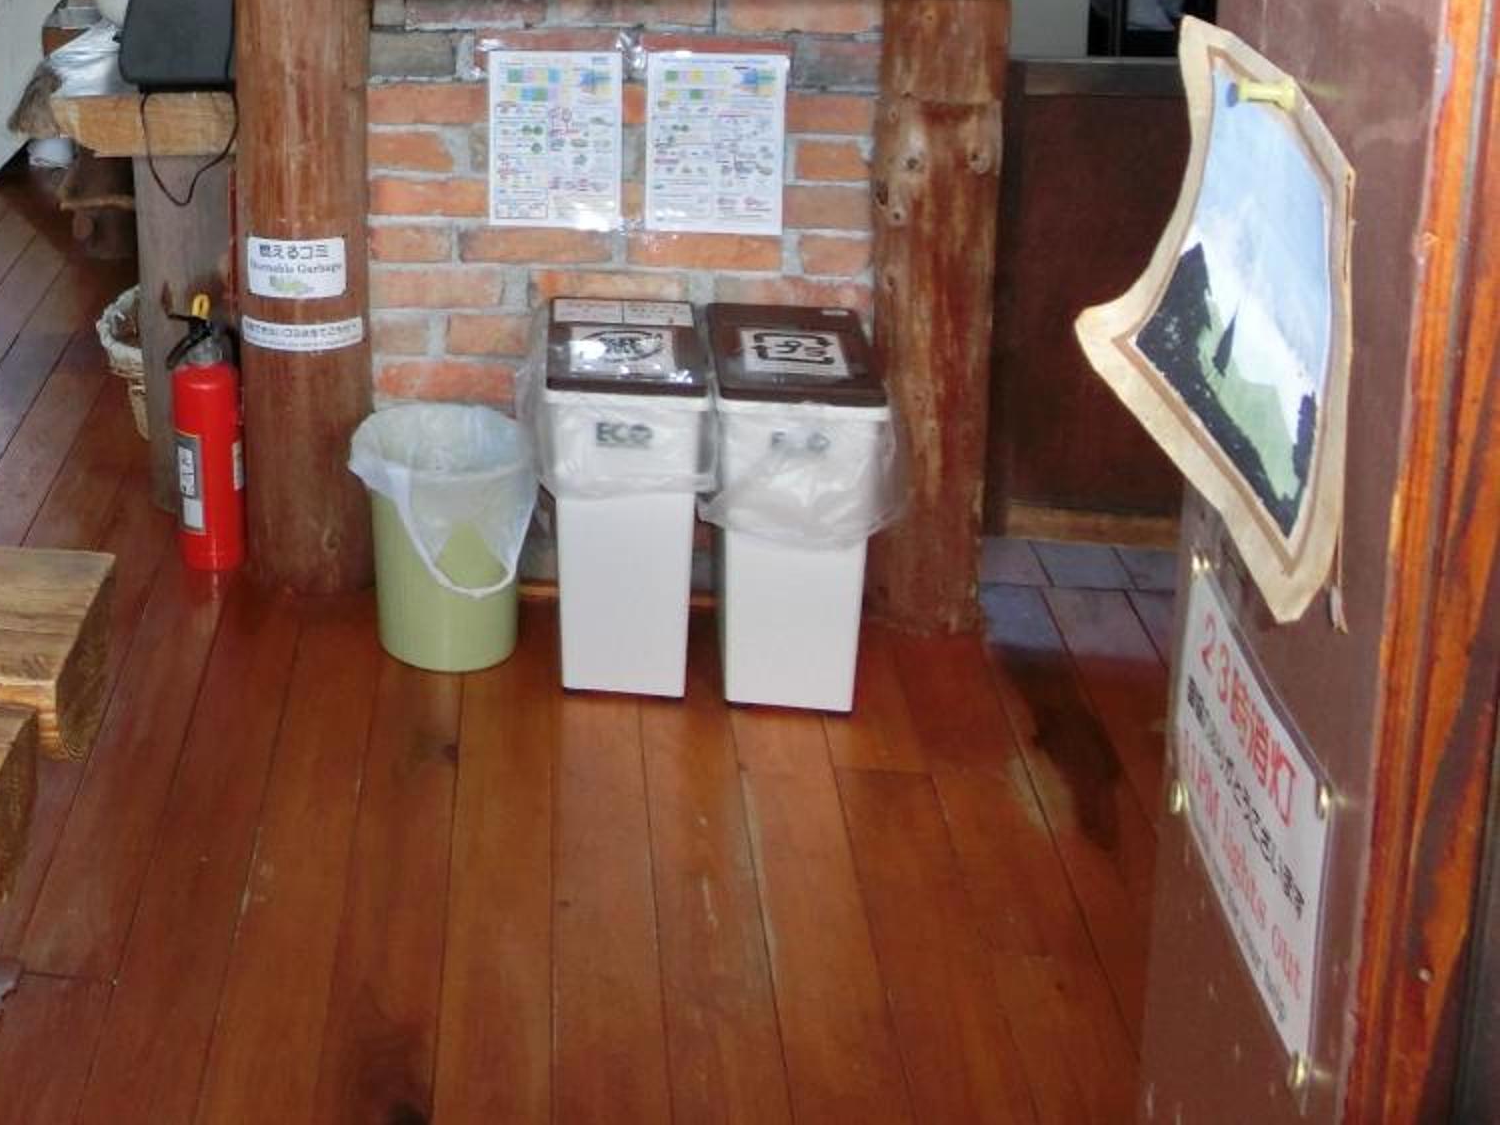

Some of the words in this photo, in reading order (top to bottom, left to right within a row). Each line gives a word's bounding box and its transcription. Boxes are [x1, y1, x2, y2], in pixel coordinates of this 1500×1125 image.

[596, 422, 653, 443] ECO
[1201, 612, 1297, 827] 23時消灯
